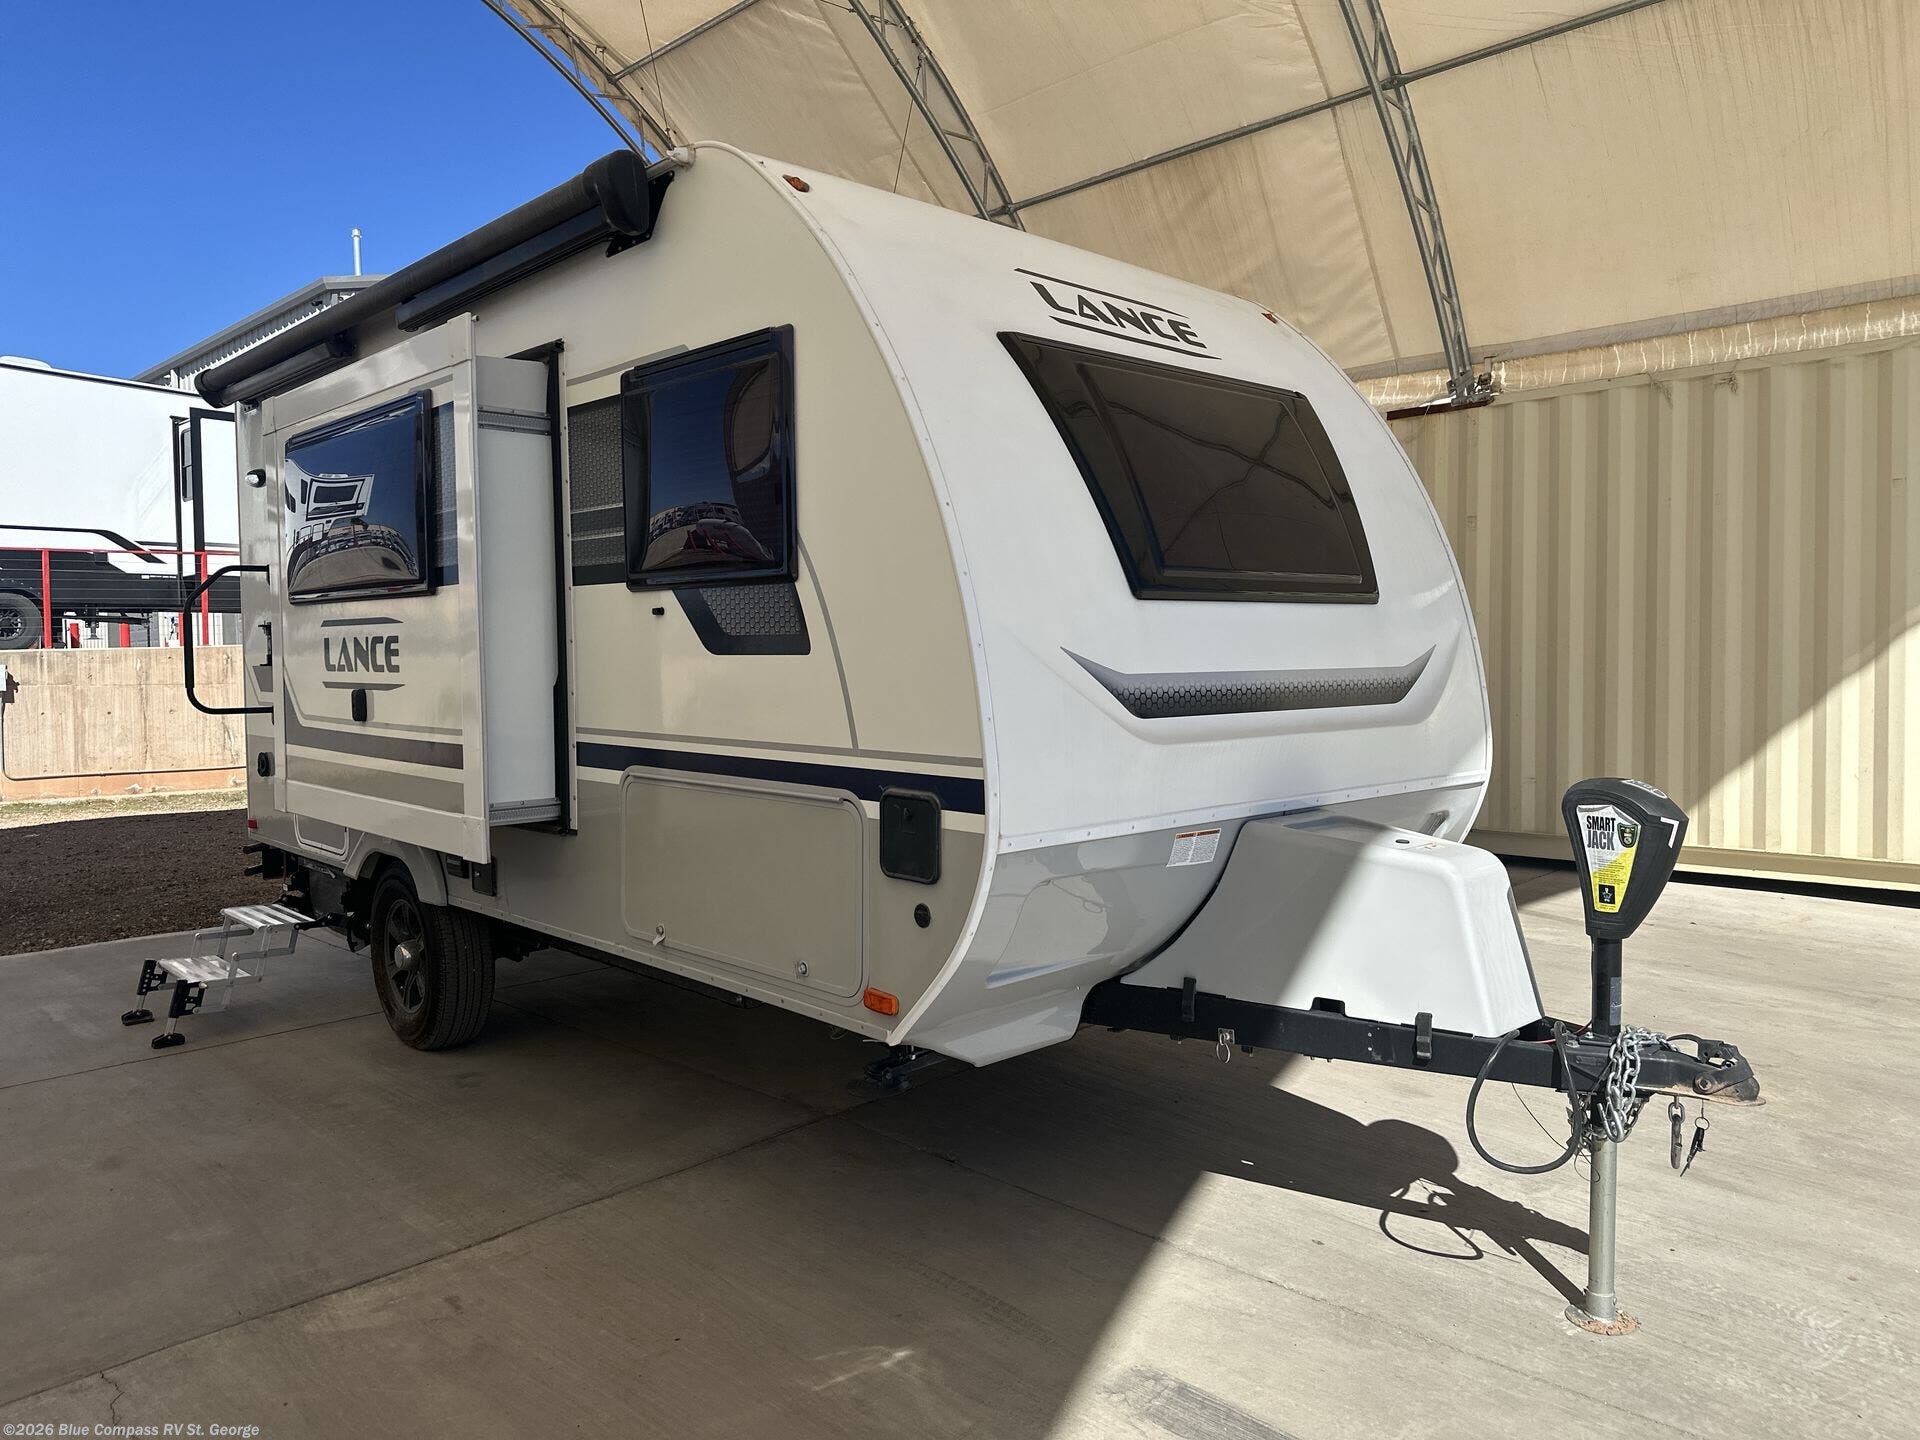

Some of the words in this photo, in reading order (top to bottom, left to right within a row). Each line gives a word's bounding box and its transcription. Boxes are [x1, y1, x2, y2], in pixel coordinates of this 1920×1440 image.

[1029, 281, 1207, 349] LANCE
[324, 635, 400, 673] LANCE
[1586, 815, 1616, 832] SMART
[1587, 830, 1615, 850] JACK
